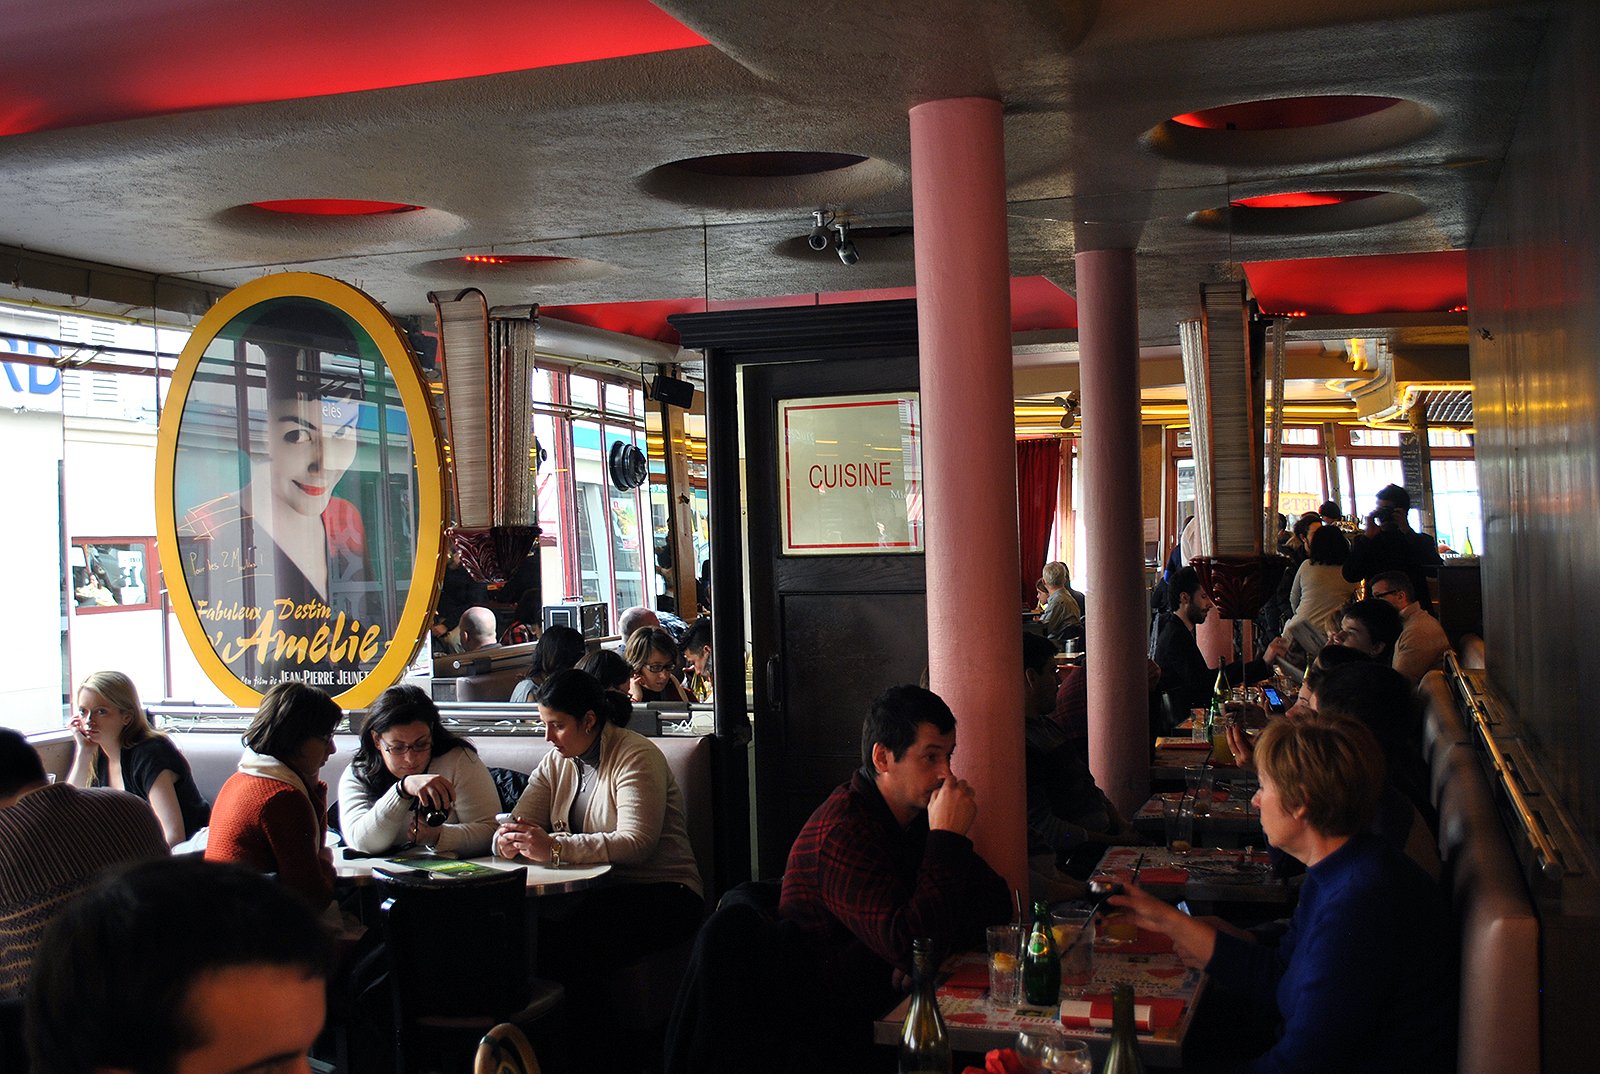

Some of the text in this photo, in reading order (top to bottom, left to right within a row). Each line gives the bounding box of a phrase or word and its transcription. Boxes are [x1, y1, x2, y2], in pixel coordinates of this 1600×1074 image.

[809, 462, 892, 489] CUISINE
[197, 597, 331, 621] Fabuleux Destin
[279, 669, 335, 686] JEAN-PIERRE
